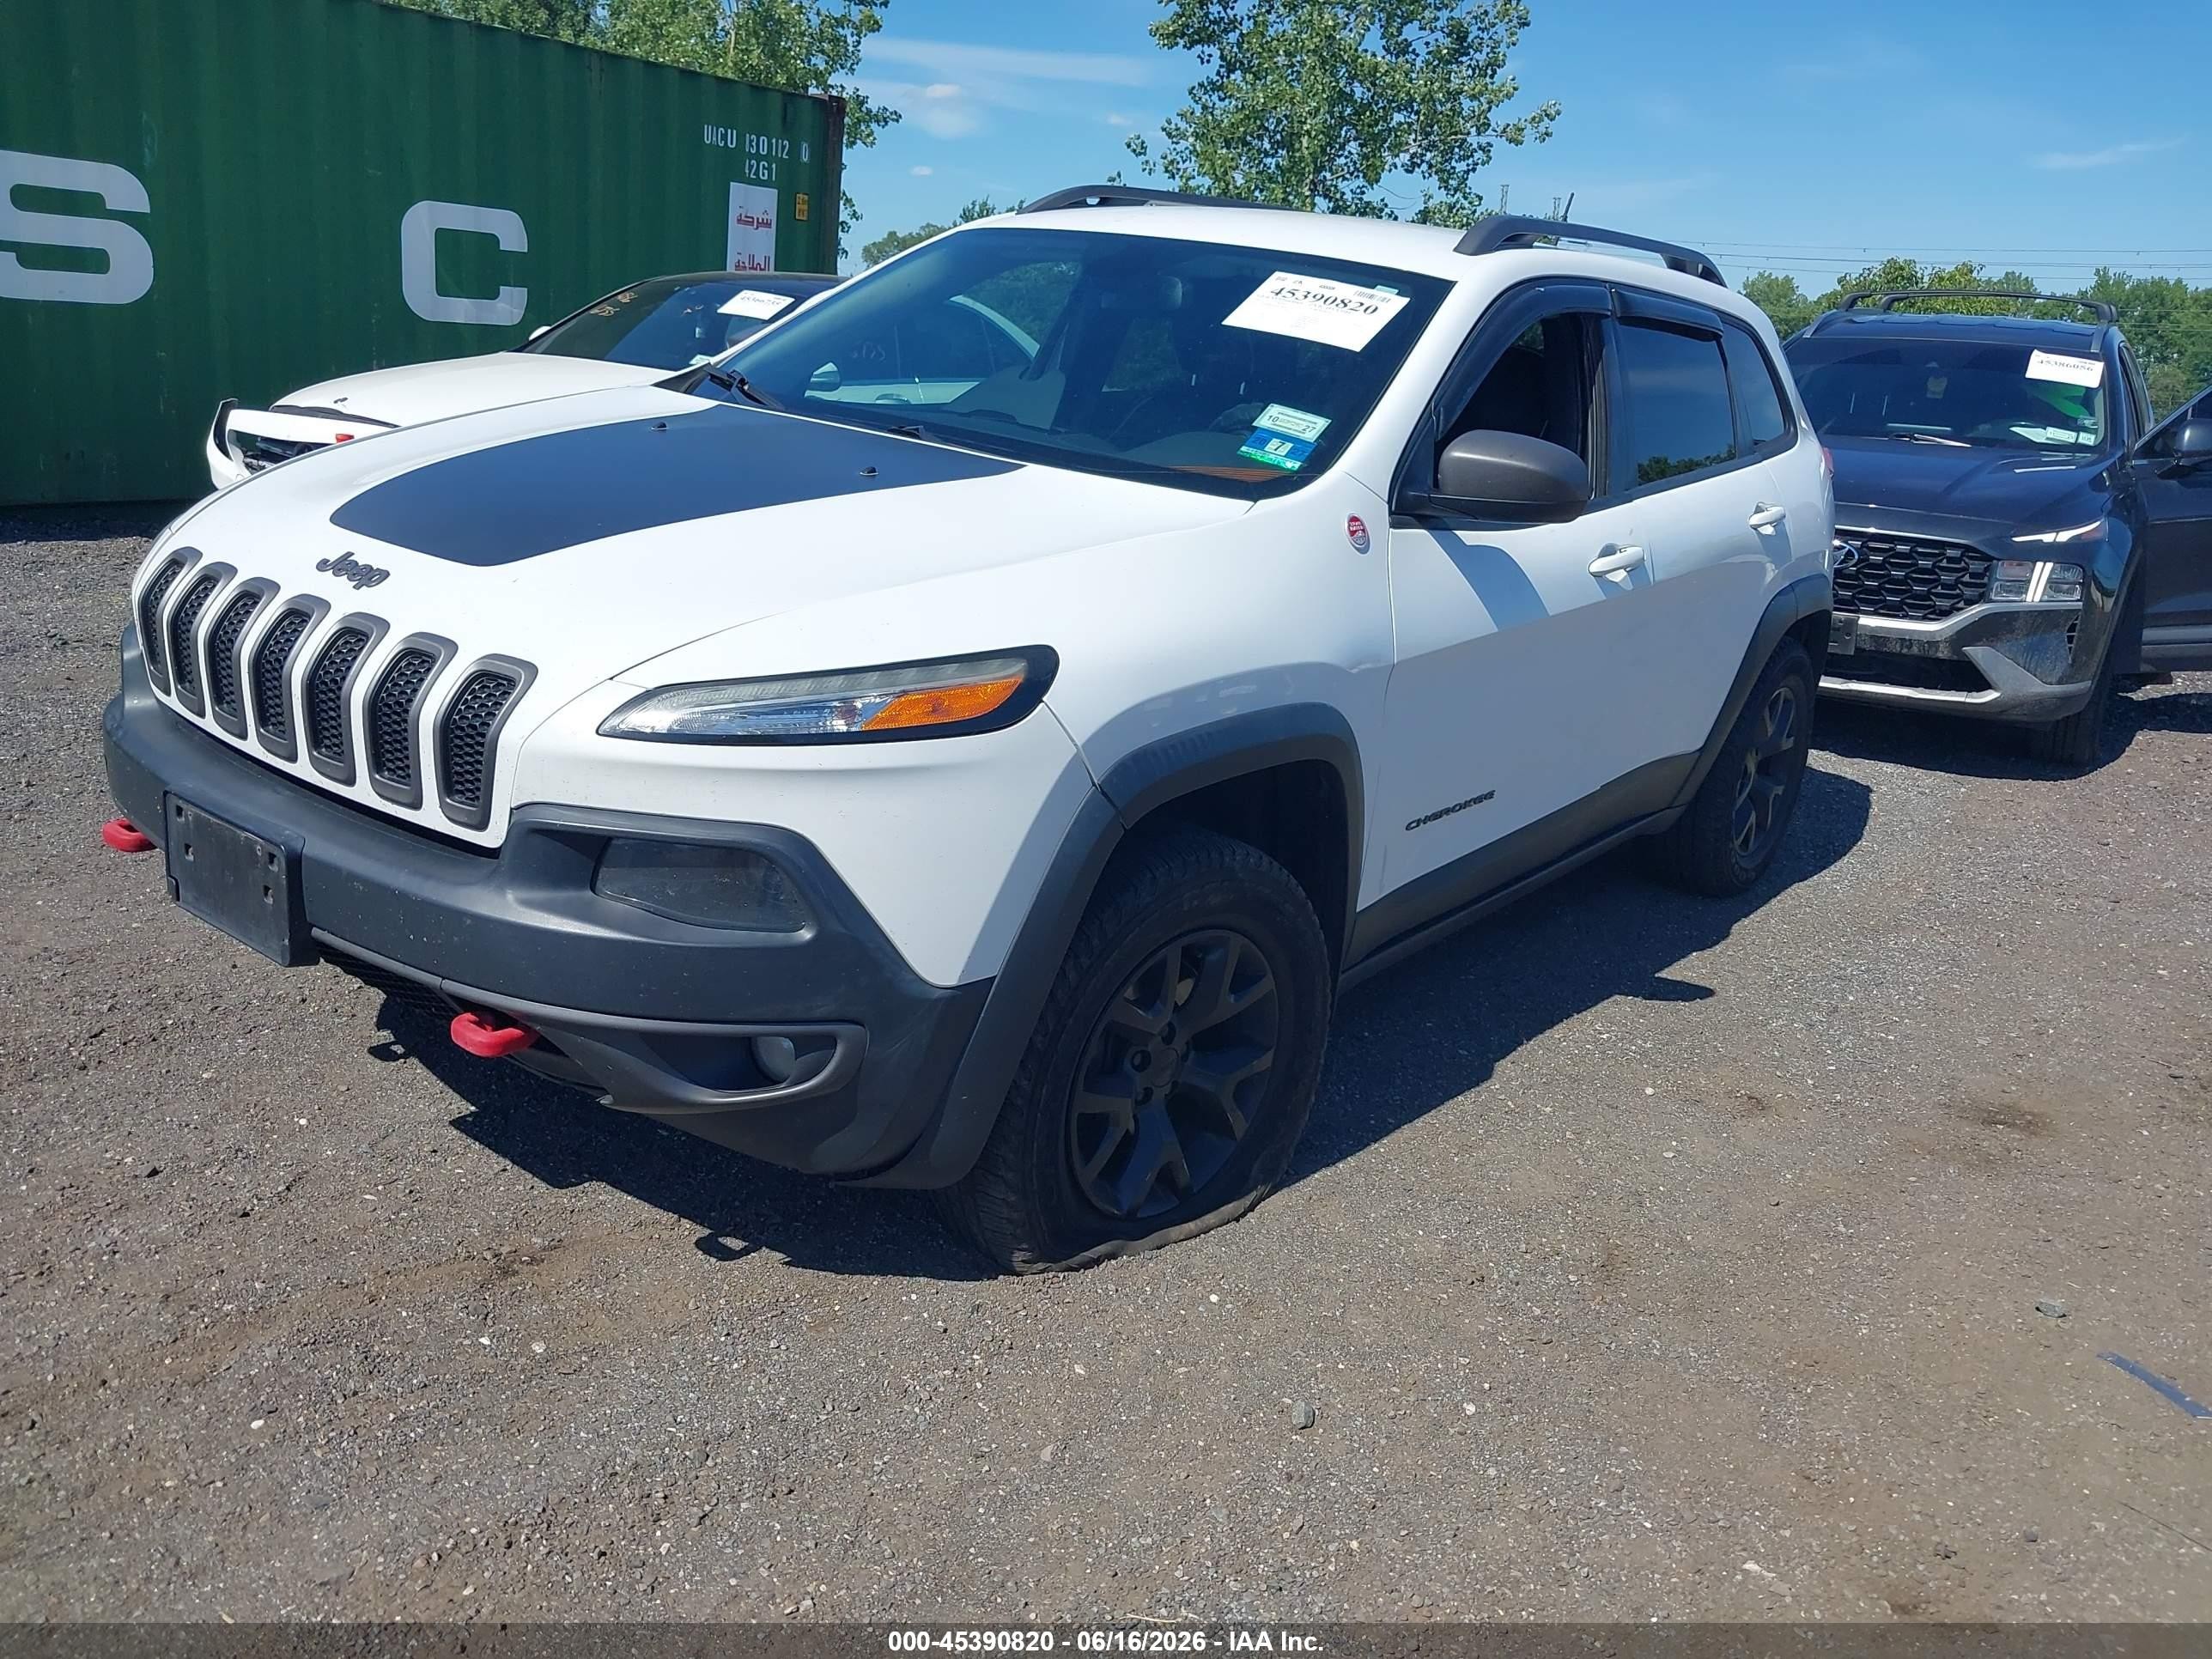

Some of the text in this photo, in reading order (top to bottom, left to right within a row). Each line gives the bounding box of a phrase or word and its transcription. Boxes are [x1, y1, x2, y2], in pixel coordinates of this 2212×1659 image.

[703, 124, 737, 149] UACU
[736, 205, 772, 230] شركة
[0, 149, 528, 325] S C
[734, 252, 771, 272] الملاحة
[1270, 286, 1379, 315] 45390820
[1267, 415, 1279, 423] 10
[1301, 424, 1316, 433] 27
[1274, 441, 1285, 452] 7
[315, 550, 391, 591] Jeep
[1405, 789, 1496, 831] CHEROKEE
